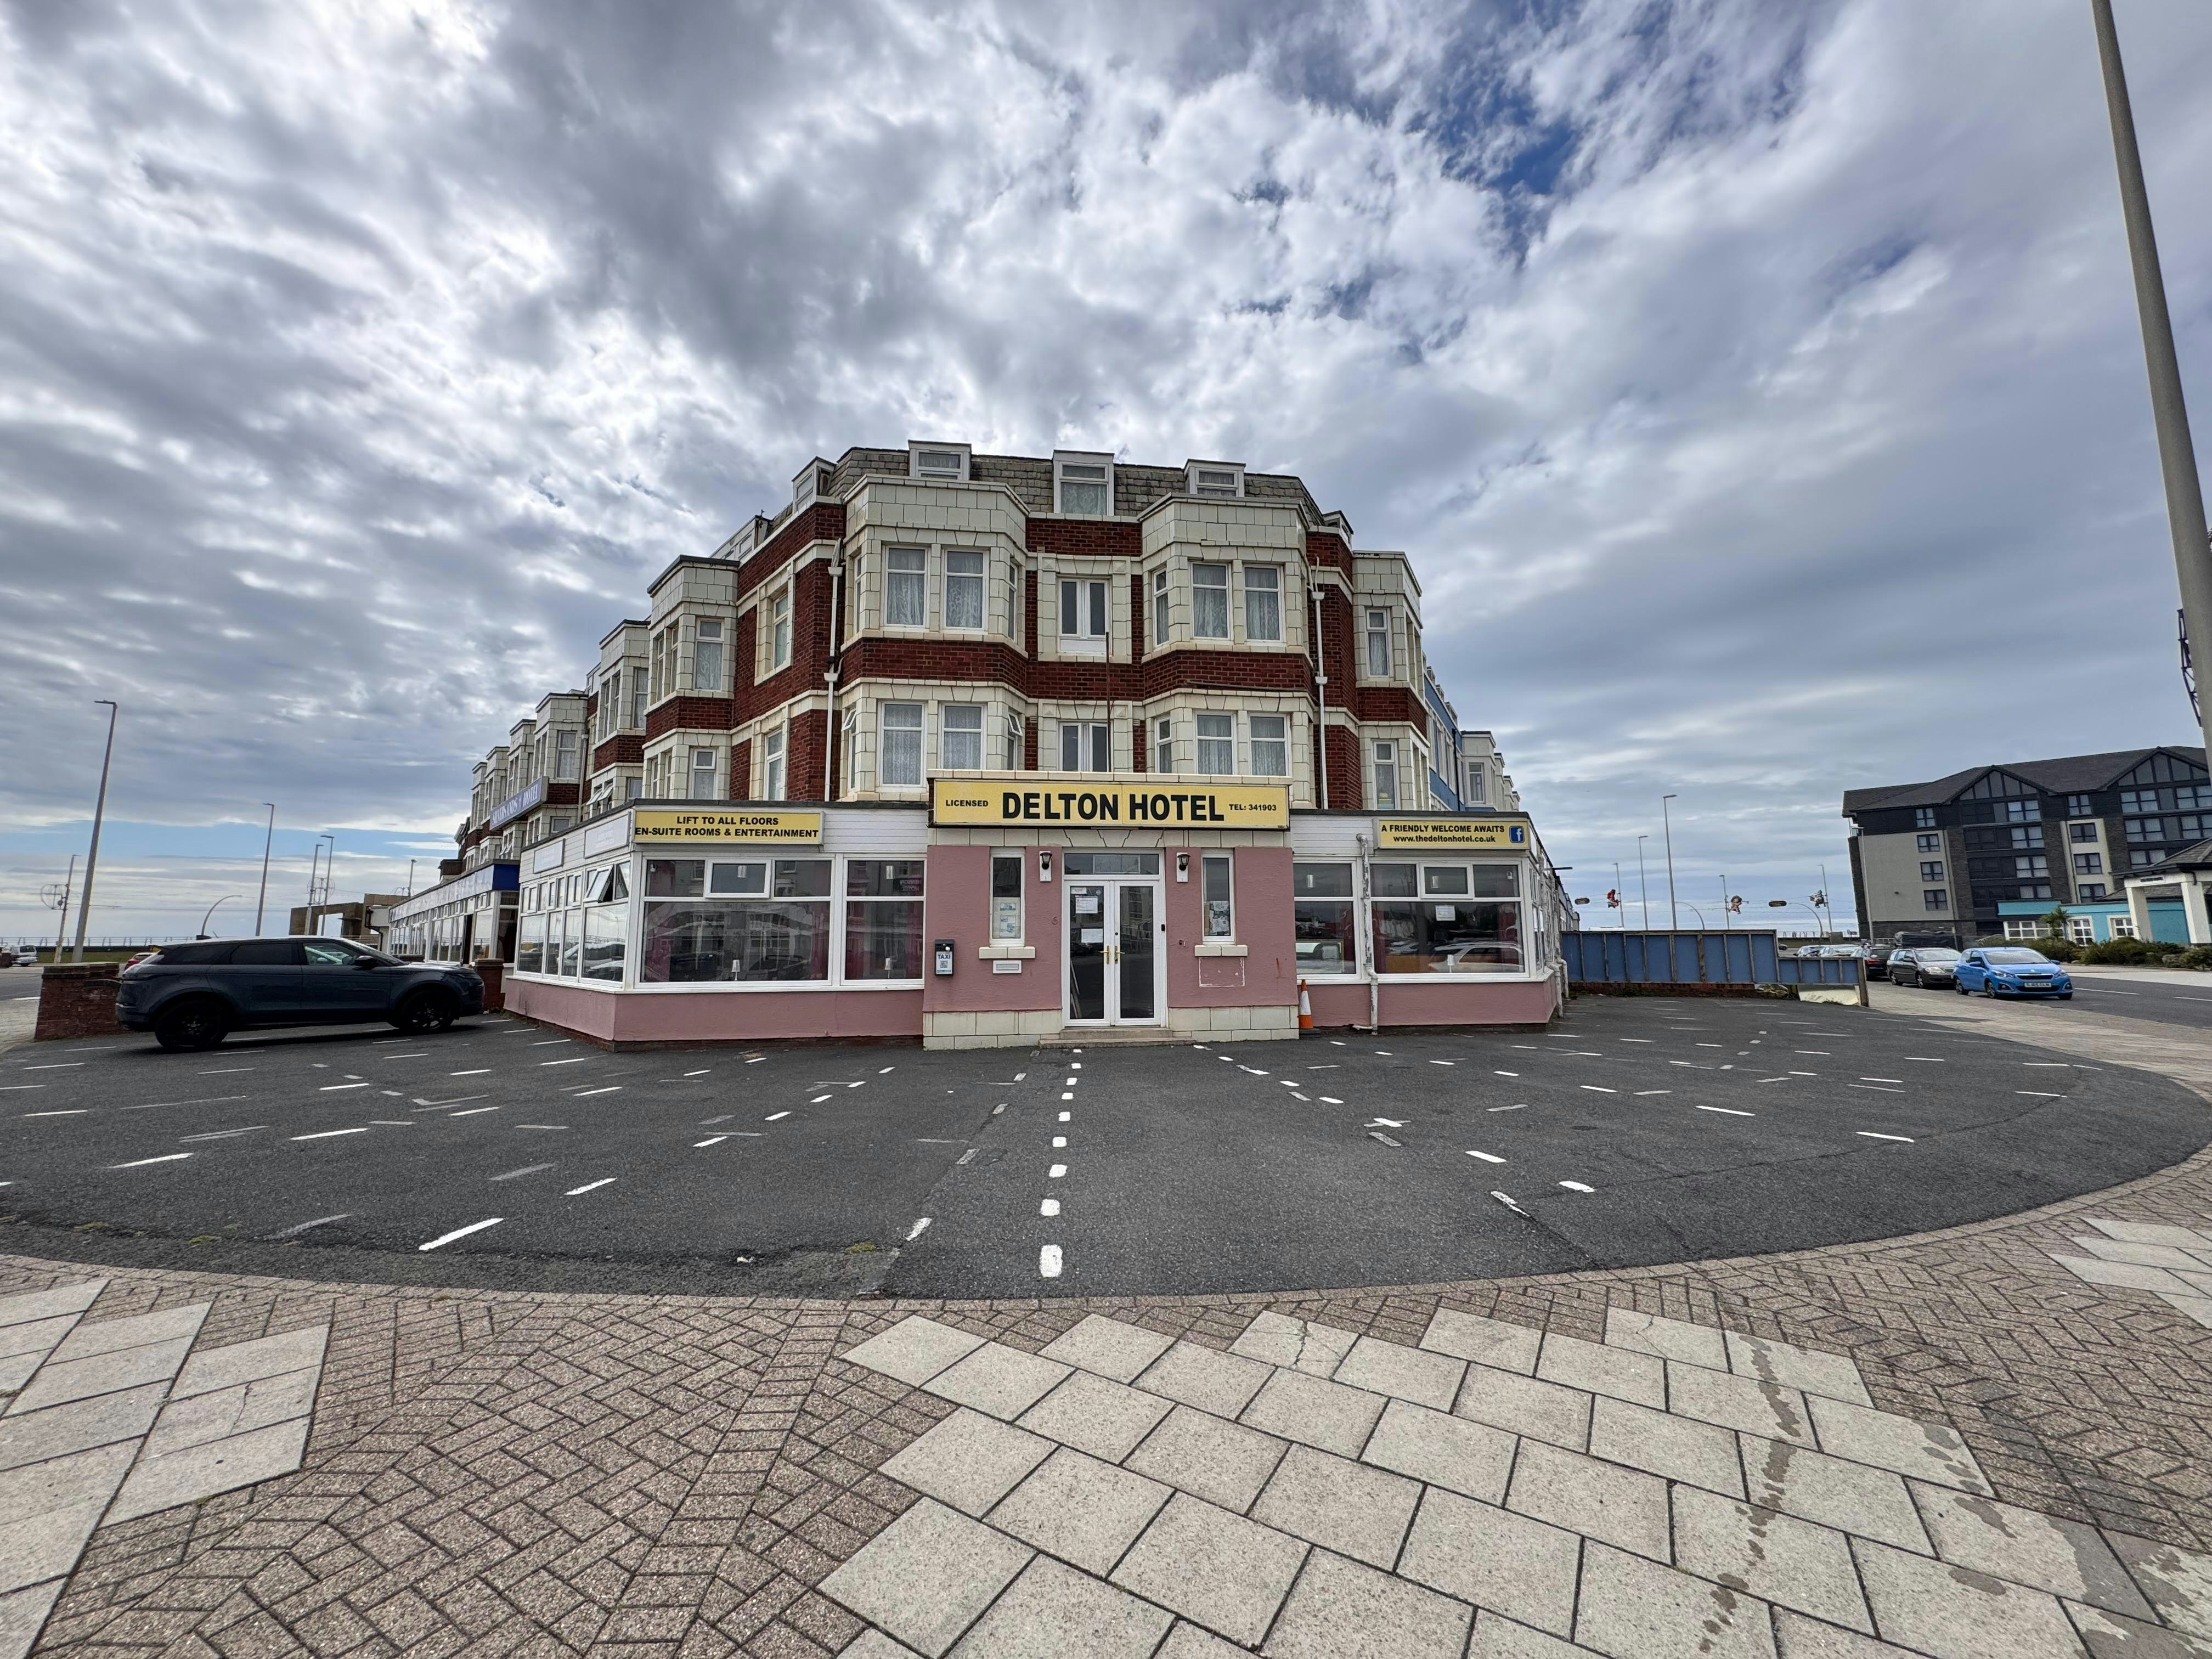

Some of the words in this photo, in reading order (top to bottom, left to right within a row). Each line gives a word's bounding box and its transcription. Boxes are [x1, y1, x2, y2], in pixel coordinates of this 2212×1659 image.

[1002, 792, 1119, 820] DELTON
[1129, 794, 1224, 821] HOTEL
[676, 816, 699, 825] LIFT
[701, 816, 715, 825] TO
[717, 816, 737, 825] ALL
[739, 817, 779, 826] FLOORS
[635, 827, 682, 836] EN-SUITE
[685, 828, 721, 836] ROOMS
[724, 828, 731, 836] &
[735, 828, 819, 838] ENTERTAINMENT
[1393, 834, 1496, 843] www.thedeltonhotel.co.uk
